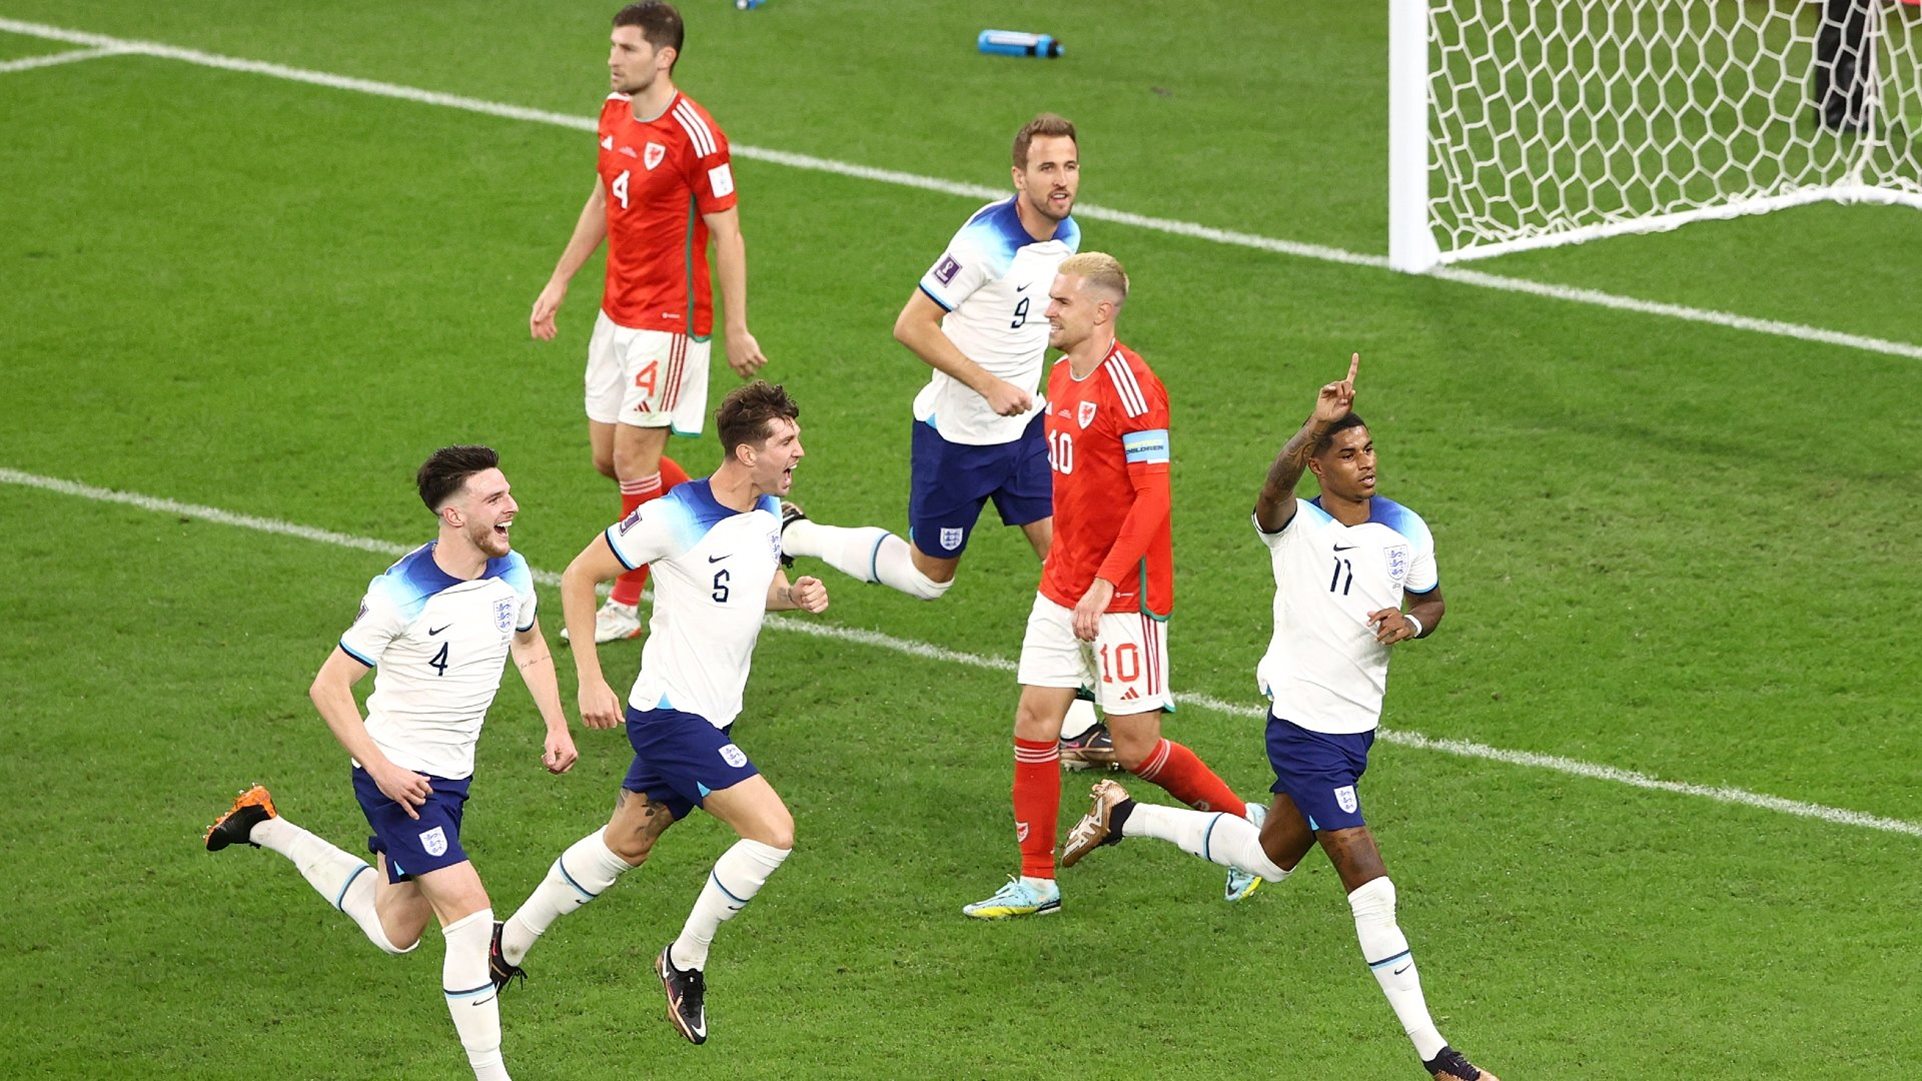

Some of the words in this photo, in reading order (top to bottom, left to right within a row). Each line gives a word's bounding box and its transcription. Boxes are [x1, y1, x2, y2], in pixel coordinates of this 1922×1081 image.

[612, 170, 630, 209] 4
[1011, 297, 1030, 328] 9
[636, 359, 659, 397] 4
[1048, 429, 1073, 475] 10
[712, 568, 730, 603] 5
[1330, 556, 1353, 596] 11
[429, 641, 450, 676] 4
[1100, 643, 1139, 683] 10
